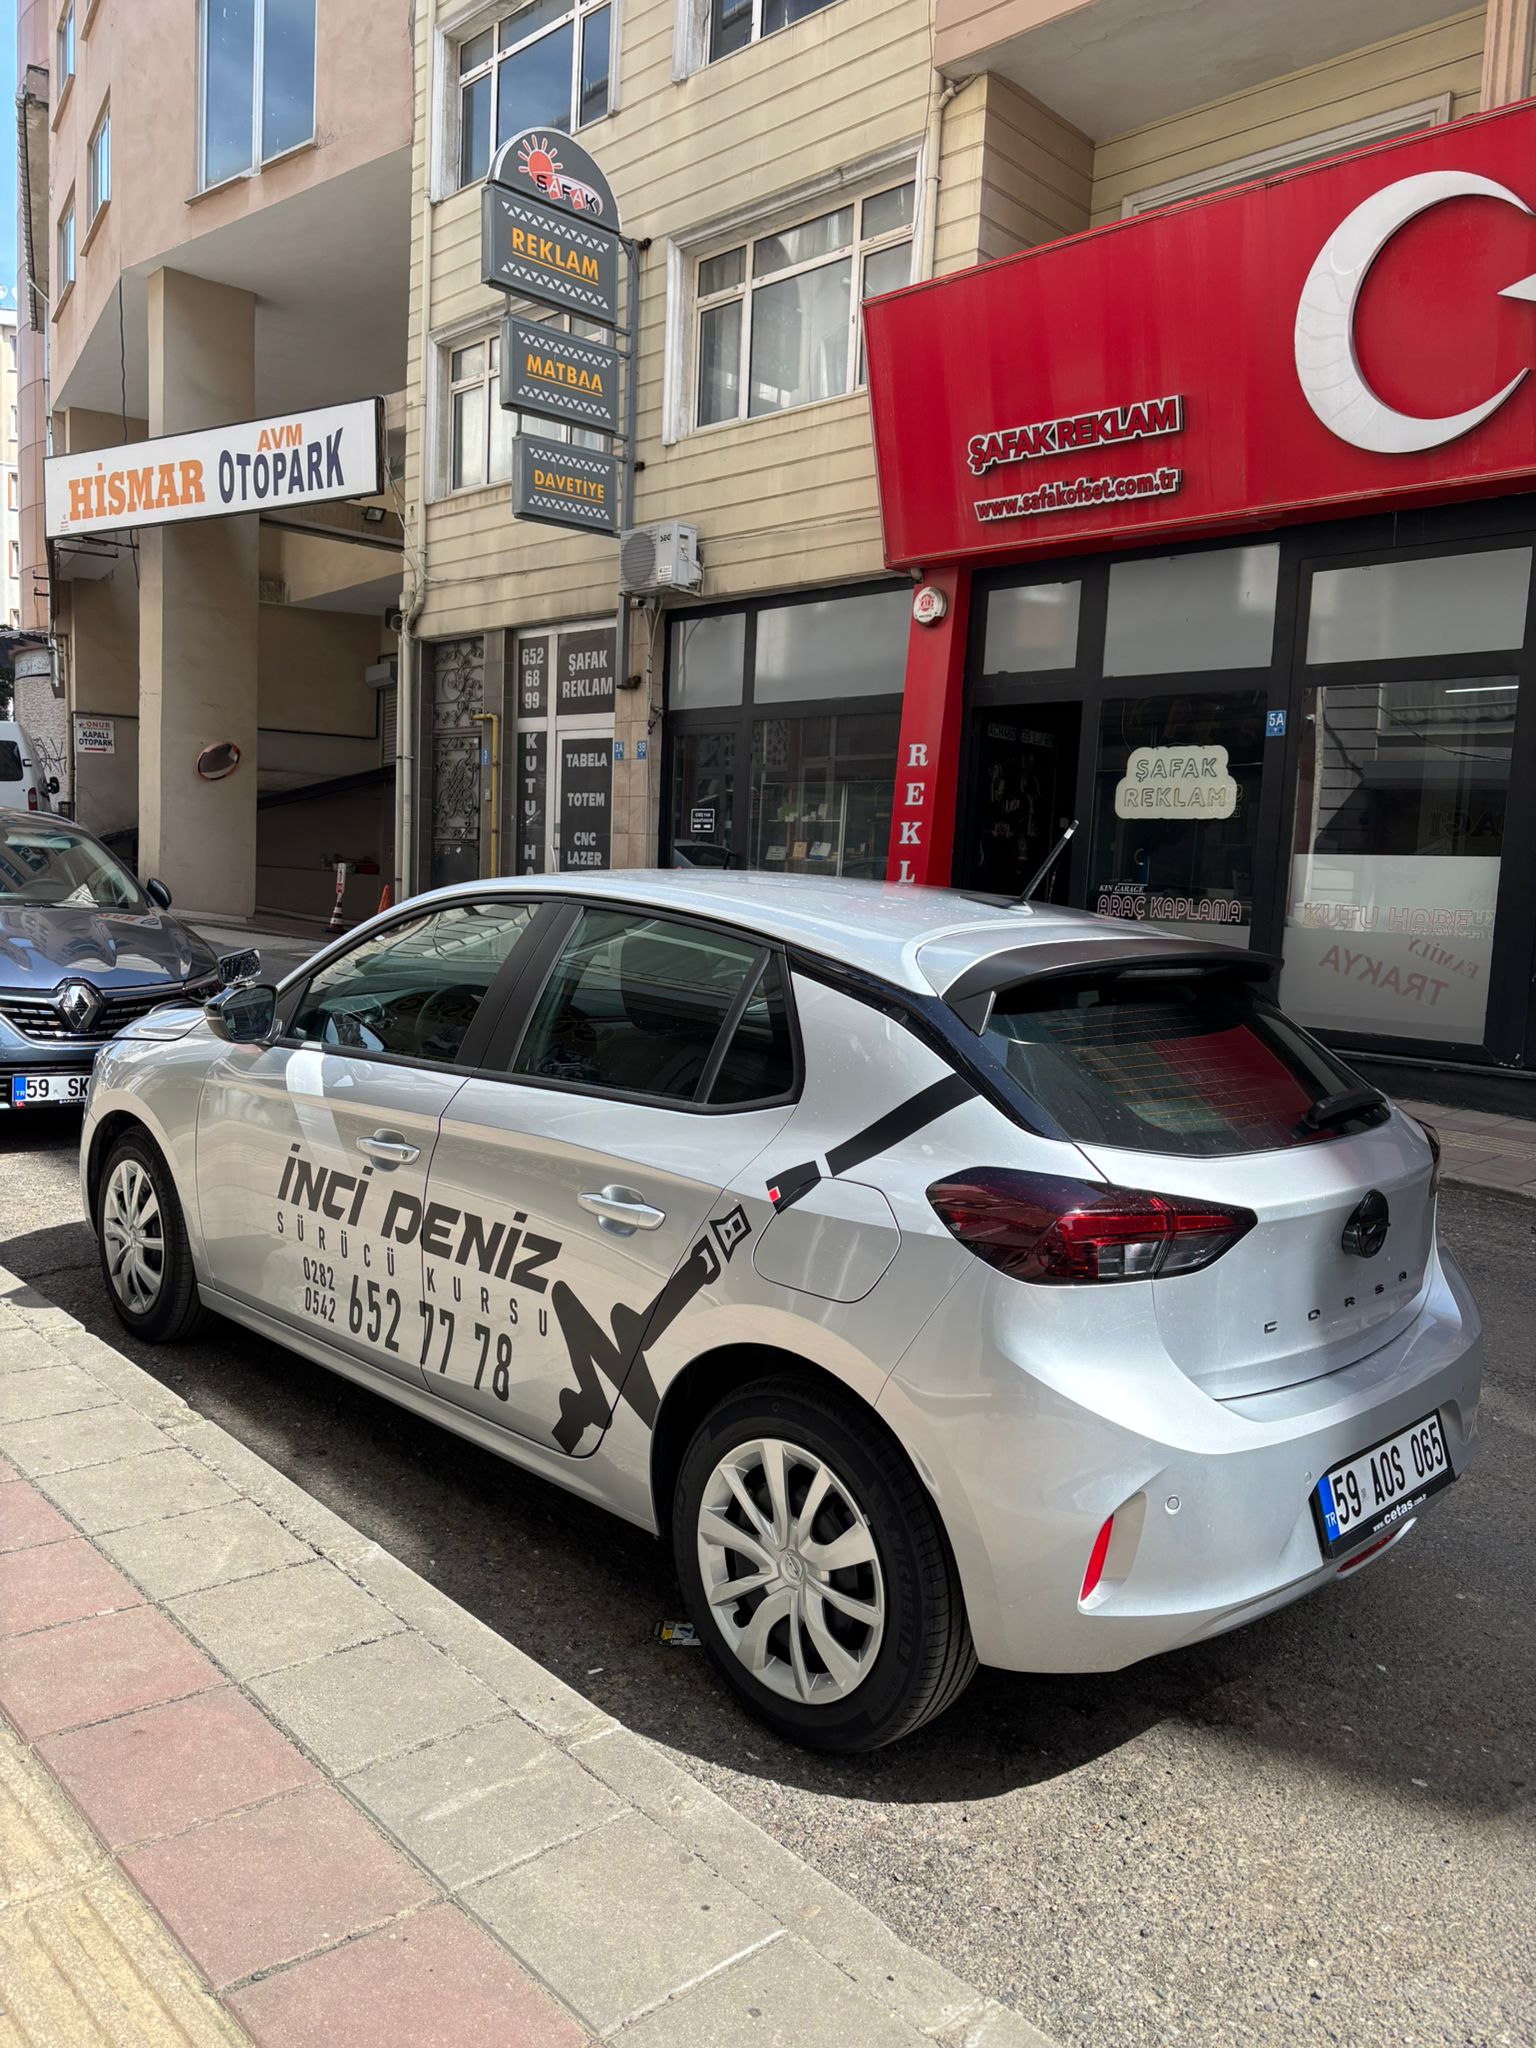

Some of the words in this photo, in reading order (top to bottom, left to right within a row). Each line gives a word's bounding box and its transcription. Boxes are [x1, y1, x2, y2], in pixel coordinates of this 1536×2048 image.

[512, 227, 599, 281] REKLAM
[527, 353, 603, 392] MATBAA
[257, 423, 303, 453] AVM
[968, 421, 1057, 474] ŞAFAK
[1056, 396, 1178, 450] REKLAM
[68, 459, 205, 521] HİSMAR
[218, 427, 345, 504] OTOPARK
[534, 469, 605, 500] DAVETİYE
[975, 468, 1178, 520] www.safakofset.com.tr
[522, 647, 544, 666] 652
[568, 650, 608, 676] ŞAFAK
[525, 670, 540, 687] 68
[562, 677, 613, 698] REKLAM
[525, 691, 540, 709] 99
[1269, 713, 1284, 727] 5A
[78, 738, 113, 747] OTOPARK
[82, 730, 109, 739] KAPALI
[566, 753, 608, 768] TABELA
[1135, 757, 1217, 782] ŞAFAK
[524, 733, 537, 816] KUTU
[567, 792, 605, 807] TOTEM
[1124, 787, 1227, 808] REKLAM
[574, 832, 597, 846] CNC
[567, 851, 602, 866] LAZER
[1097, 896, 1146, 920] ARAÇ
[1151, 897, 1242, 922] KAPLAMA
[1304, 902, 1379, 932] KUTU
[26, 1078, 49, 1098] 59
[68, 1077, 90, 1097] SK
[277, 1143, 373, 1227] İNCİ
[381, 1189, 563, 1294] DENİZ
[277, 1211, 395, 1277] SÜRÜCÜ
[426, 1266, 548, 1337] KURSU
[303, 1256, 335, 1292] 0282
[304, 1287, 336, 1323] 0542
[1264, 1270, 1408, 1334] CORSA
[349, 1274, 401, 1353] 652
[419, 1300, 455, 1374] 77
[474, 1322, 512, 1402] 78
[1332, 1470, 1362, 1525] 59
[1370, 1445, 1406, 1506] AOS
[1410, 1421, 1444, 1478] 065
[1325, 1511, 1337, 1528] TR
